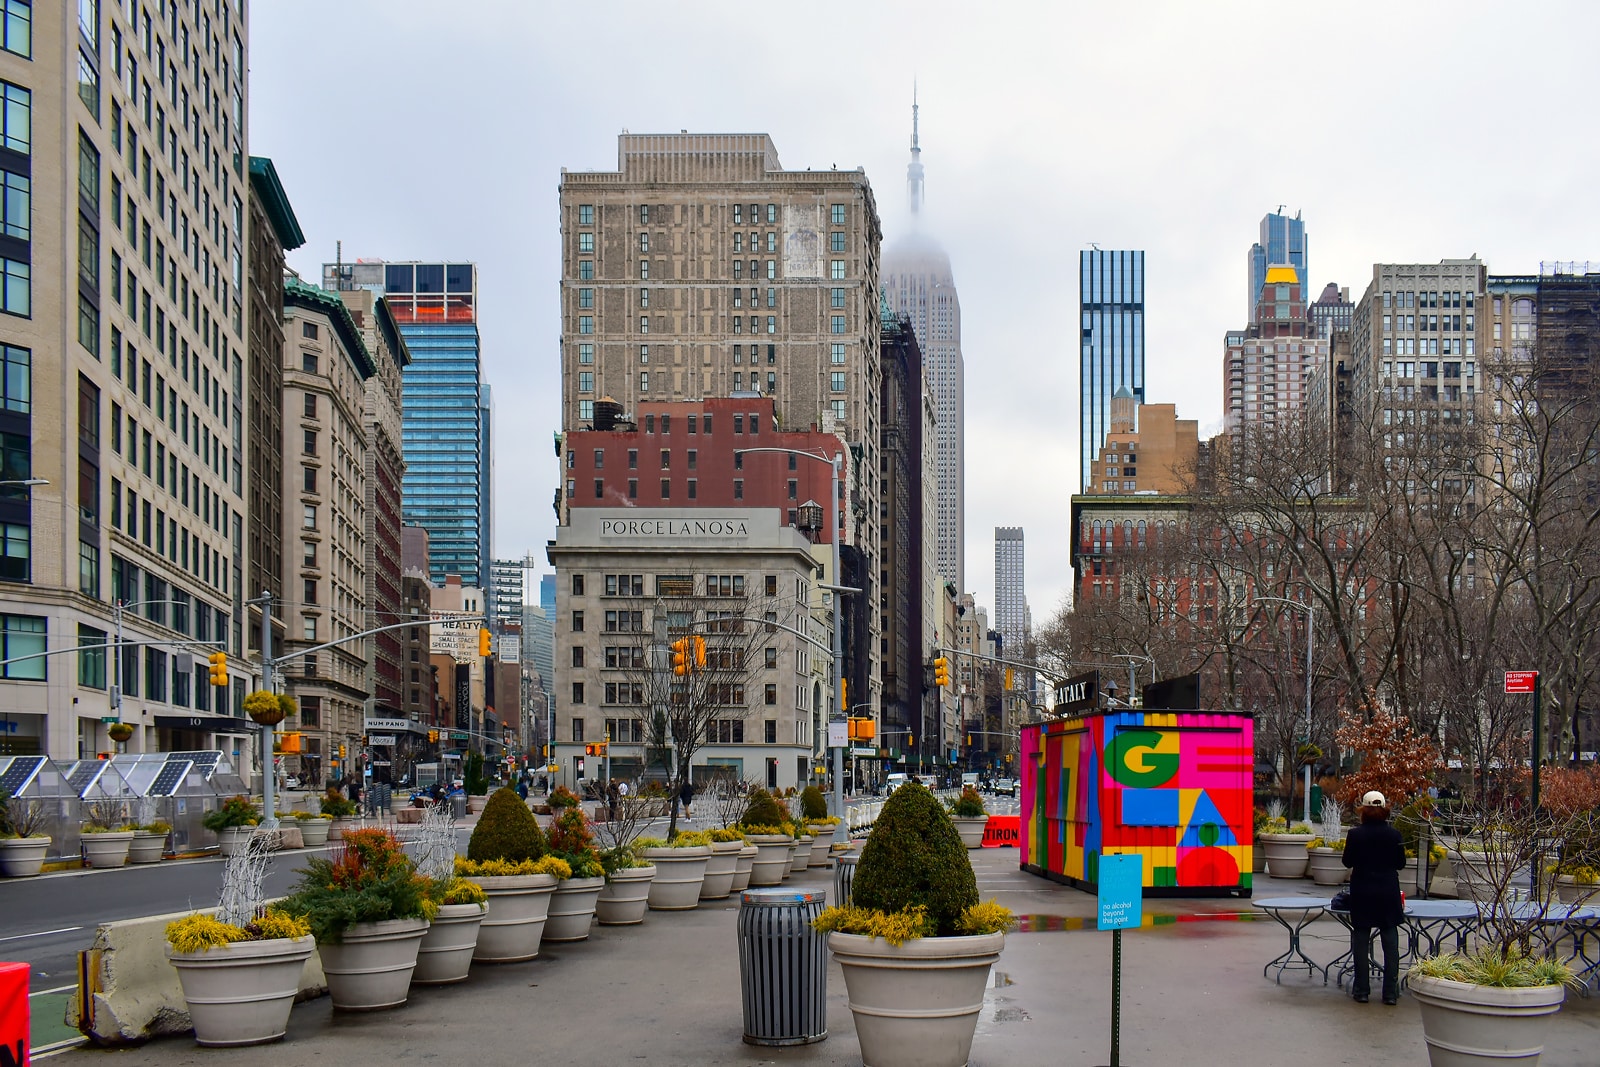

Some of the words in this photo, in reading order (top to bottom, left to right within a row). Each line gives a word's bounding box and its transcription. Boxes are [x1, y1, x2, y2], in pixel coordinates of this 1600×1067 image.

[602, 521, 748, 535] PORCELANOSA
[442, 620, 480, 629] REALTY
[982, 829, 1018, 841] TIRON
[1112, 901, 1131, 909] alcohol
[1103, 909, 1124, 917] beyond
[1114, 916, 1128, 924] point
